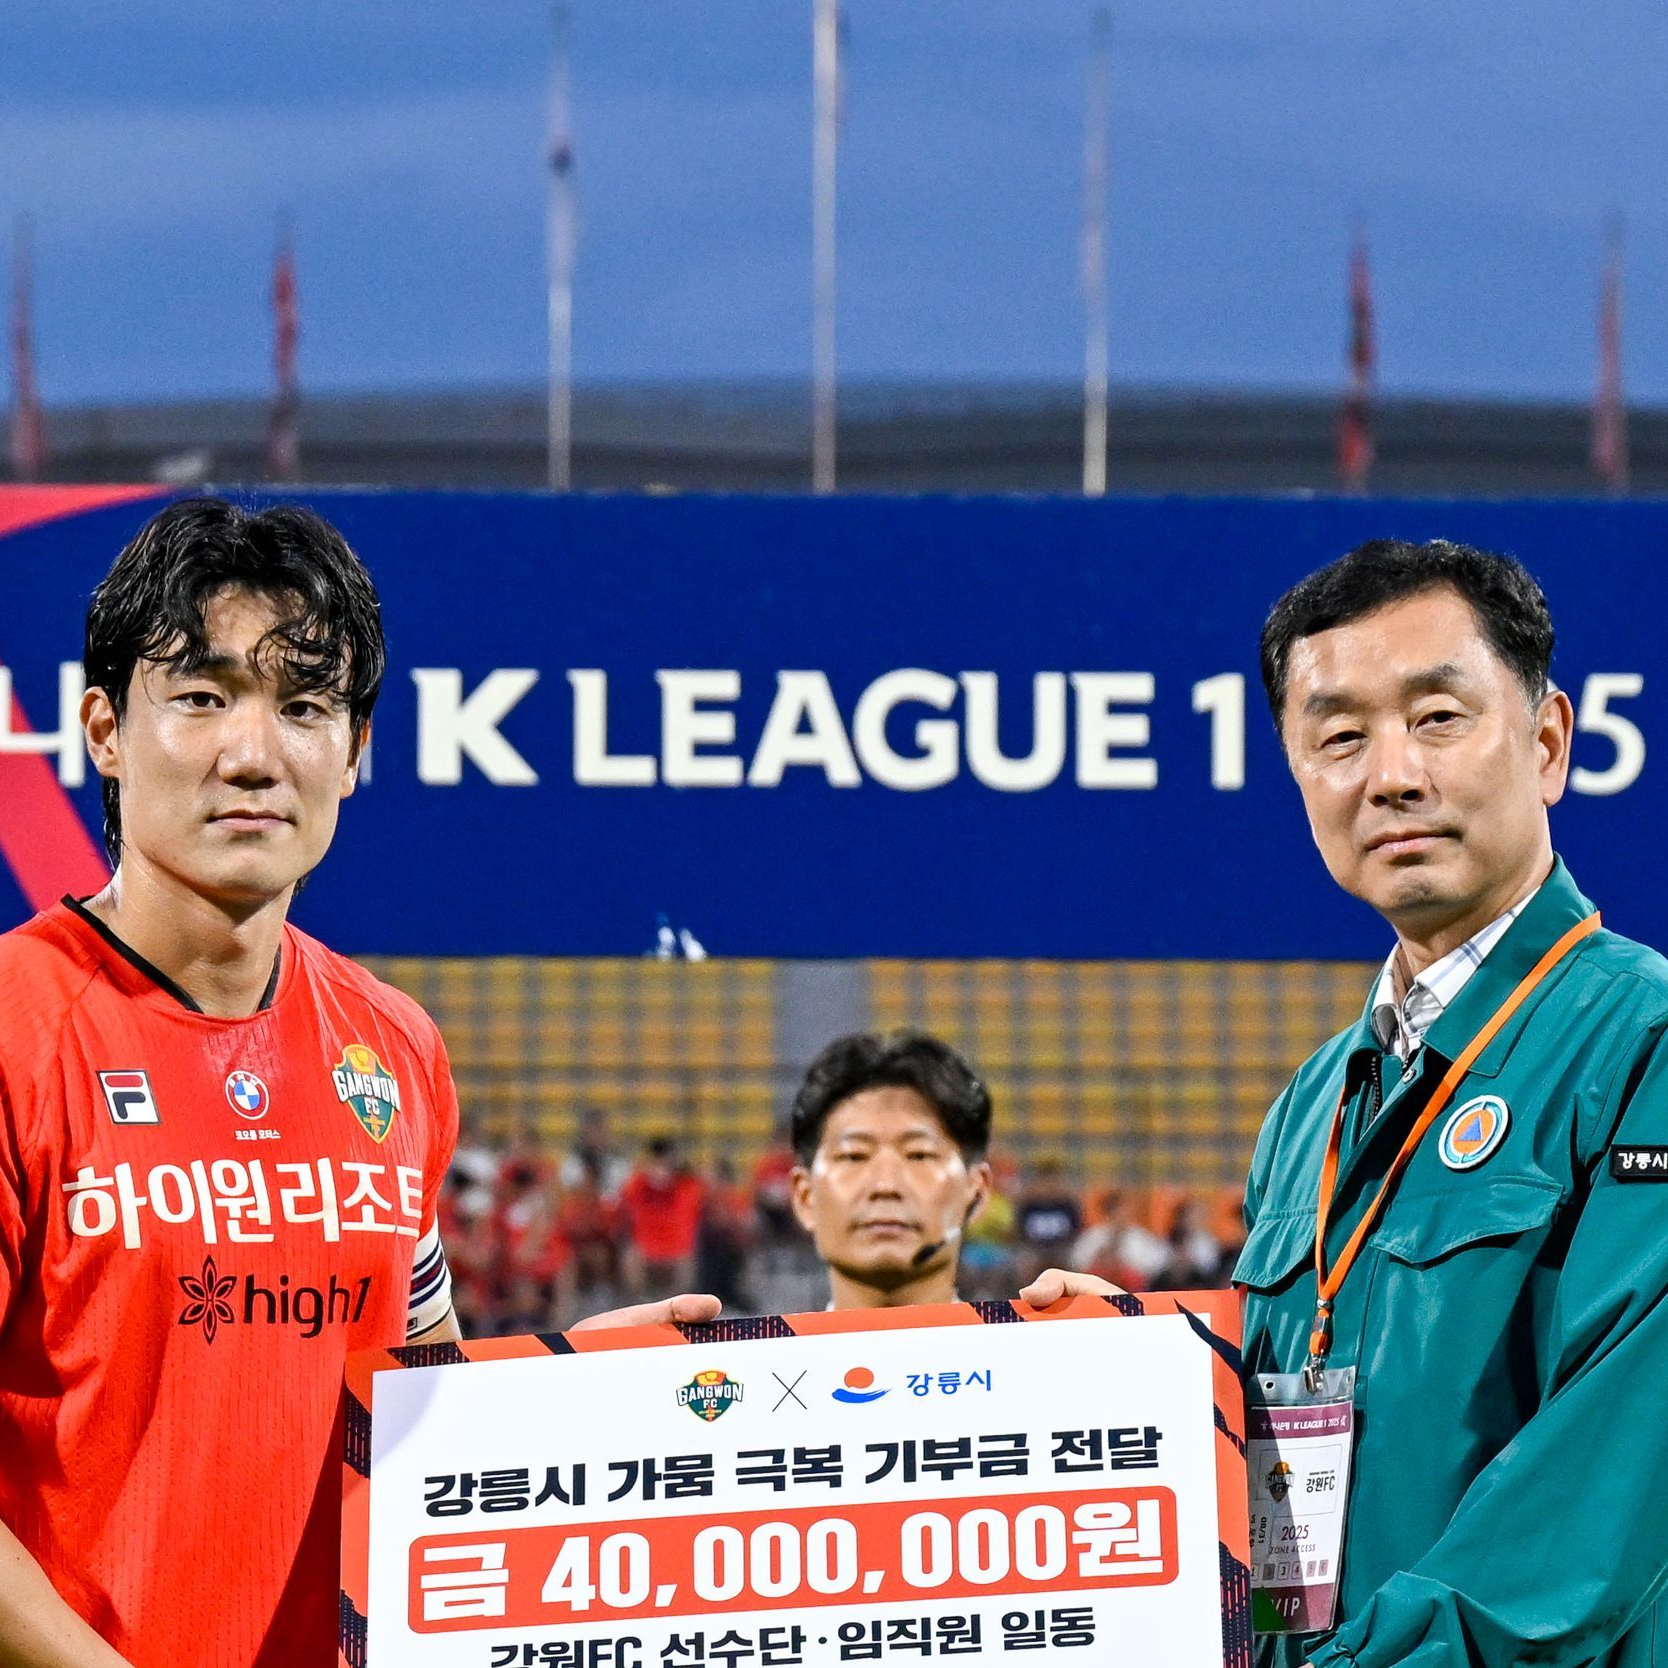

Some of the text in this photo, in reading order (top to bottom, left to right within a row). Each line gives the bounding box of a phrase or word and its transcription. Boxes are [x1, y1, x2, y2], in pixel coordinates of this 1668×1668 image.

[411, 668, 538, 786] K
[566, 668, 1158, 791] LEAGUE
[1192, 673, 1246, 789] 1
[332, 1069, 401, 1112] GANGWON
[363, 1097, 380, 1115] FC
[243, 1274, 372, 1338] high1
[676, 1382, 744, 1407] GANGWON
[906, 1370, 992, 1396] 강릉시
[703, 1397, 718, 1409] FC
[424, 1426, 1163, 1518] 강릉시 가뭄 극복 기부금 전달
[1306, 1476, 1335, 1493] 강원FC
[1281, 1525, 1309, 1541] 2025
[420, 1497, 1165, 1622] 금 40,000,000원
[1001, 1607, 1097, 1652] 일동
